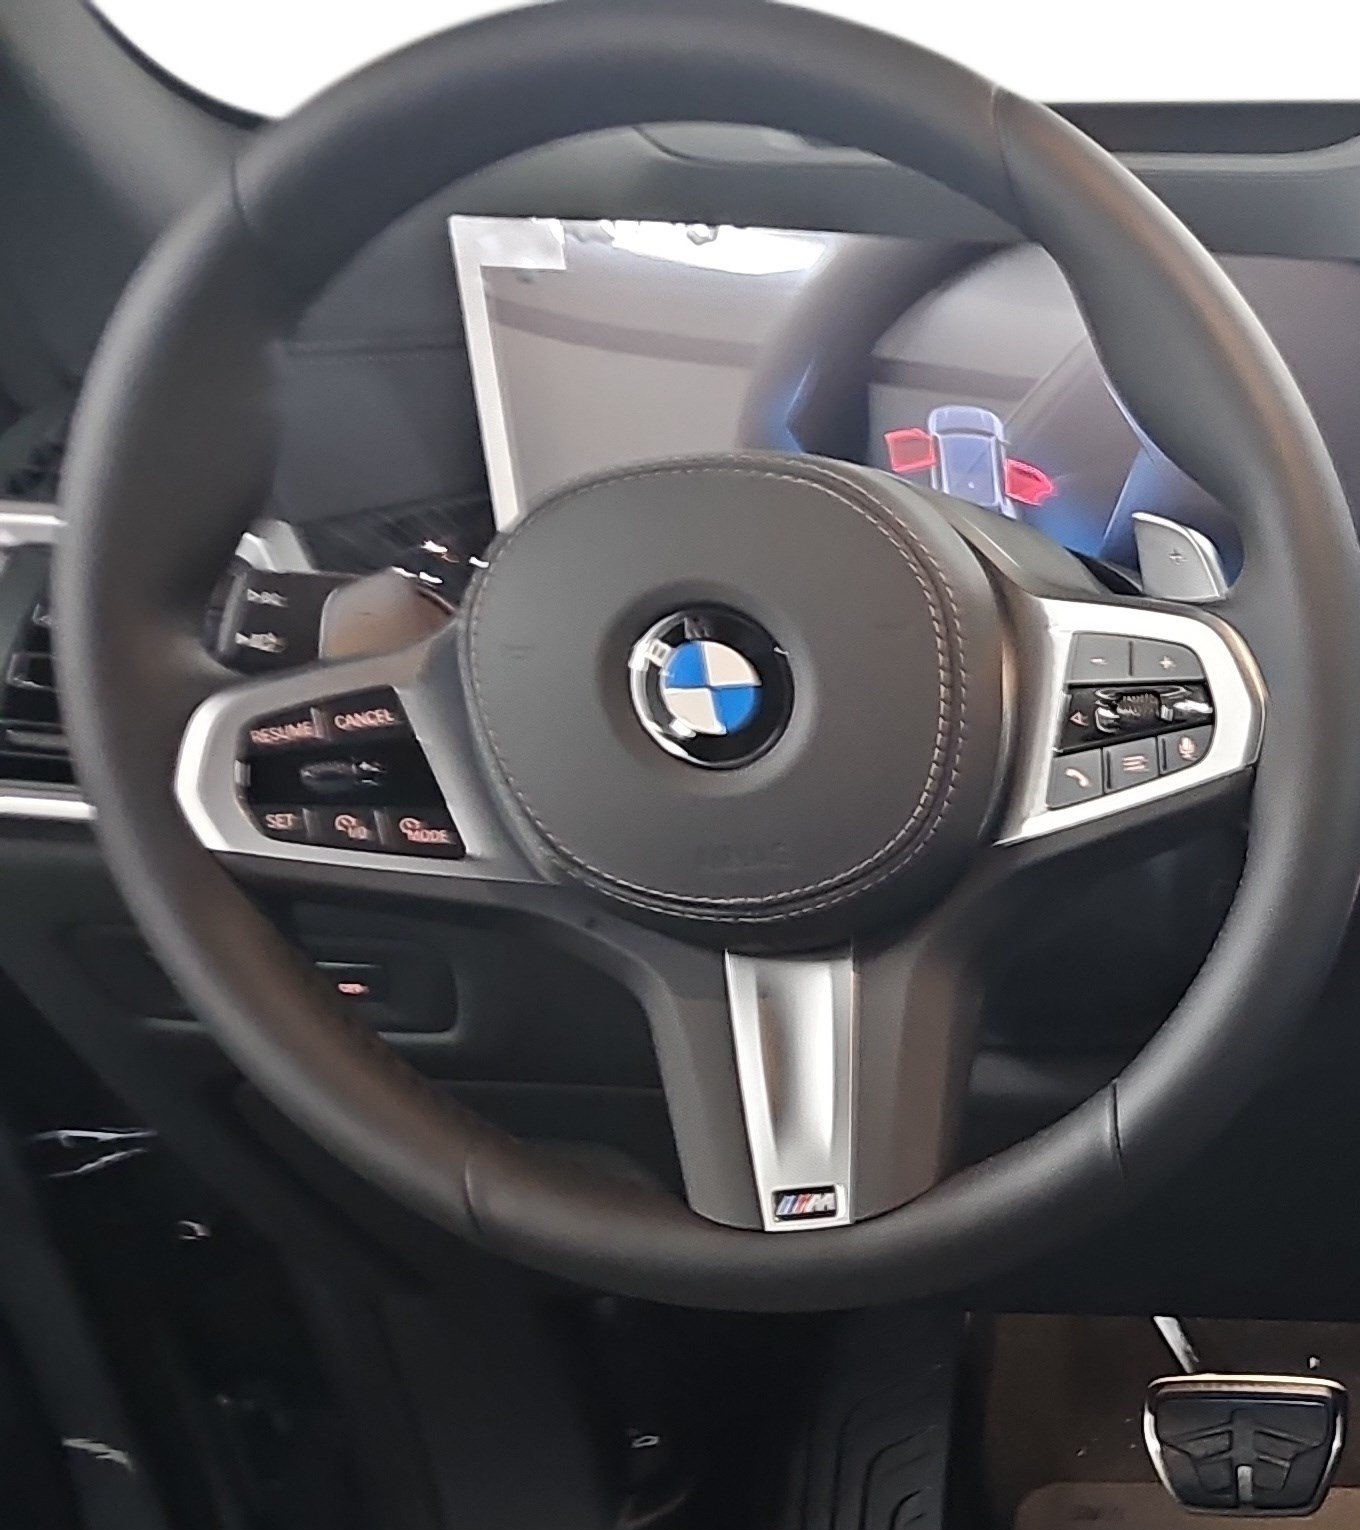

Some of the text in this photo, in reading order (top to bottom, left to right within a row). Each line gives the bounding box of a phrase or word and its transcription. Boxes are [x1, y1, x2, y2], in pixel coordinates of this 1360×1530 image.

[333, 708, 396, 731] CANCEL
[250, 720, 314, 745] RESUME
[265, 813, 298, 830] SET
[406, 829, 452, 844] MODE
